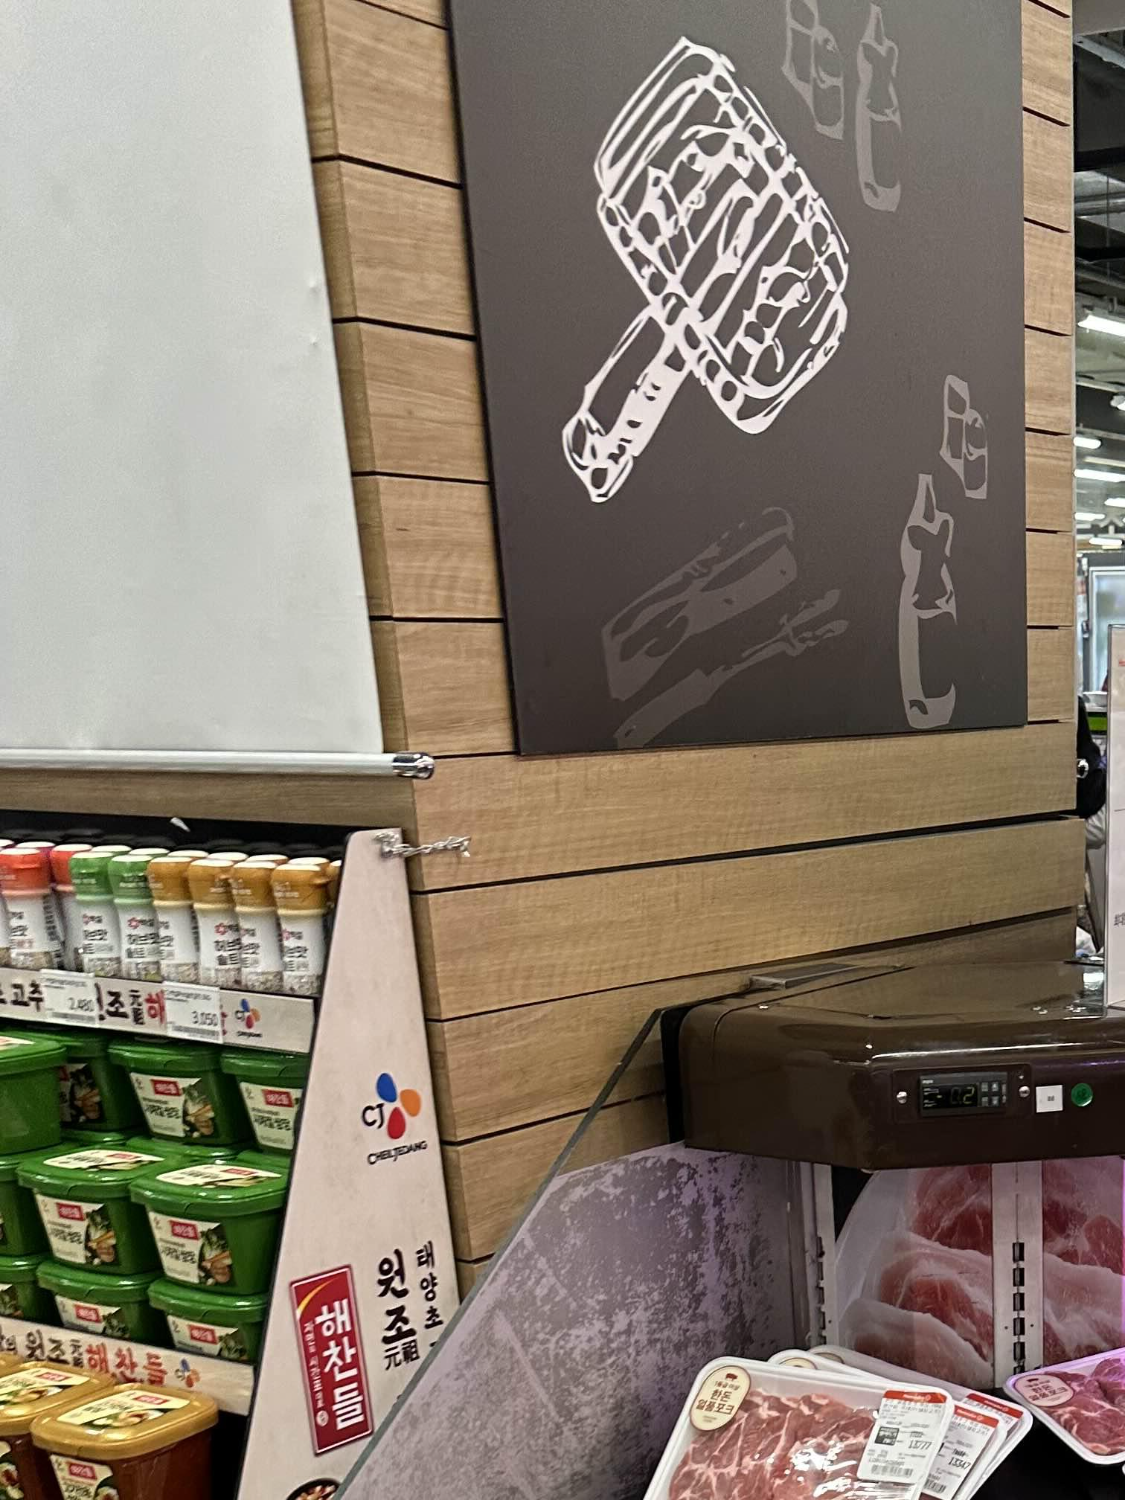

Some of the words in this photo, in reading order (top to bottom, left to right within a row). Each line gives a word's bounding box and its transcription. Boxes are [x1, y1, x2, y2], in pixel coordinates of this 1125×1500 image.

[10, 980, 44, 1012] 고추
[362, 1104, 385, 1129] CJ
[367, 1140, 428, 1165] CHEILJEDANG
[377, 1249, 417, 1345] 원조
[415, 1240, 443, 1330] 태양초
[26, 1329, 70, 1364] 원조
[85, 1342, 168, 1387] 해찬들
[315, 1298, 365, 1430] 해찬들
